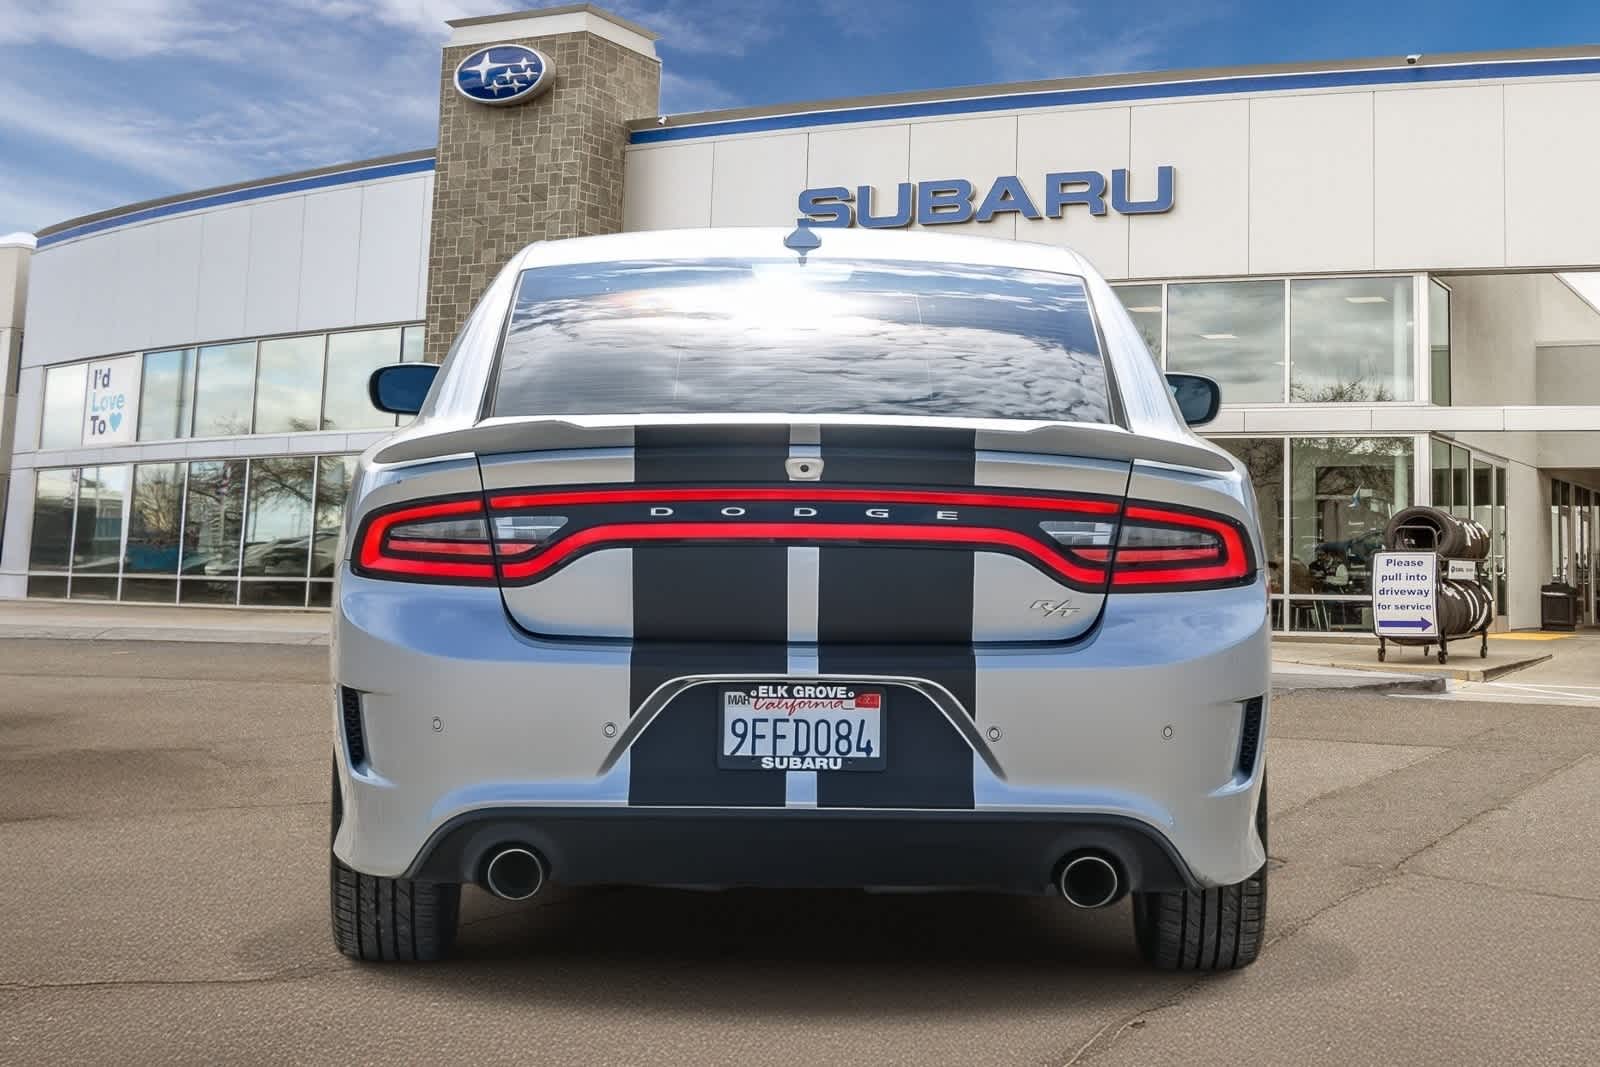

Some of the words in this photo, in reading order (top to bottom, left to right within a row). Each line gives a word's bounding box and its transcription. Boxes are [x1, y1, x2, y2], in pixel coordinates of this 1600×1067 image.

[798, 165, 1176, 228] SUBARU
[94, 368, 111, 389] I'd
[92, 392, 125, 412] Love
[91, 415, 106, 435] To
[650, 506, 959, 520] DODGE
[1386, 558, 1424, 567] Please
[1381, 573, 1402, 583] pull
[1405, 573, 1428, 581] into
[1378, 587, 1430, 598] driveway
[1029, 599, 1081, 617] R/T
[758, 685, 787, 697] ELK
[793, 686, 847, 698] GROVE
[753, 697, 844, 716] California
[730, 718, 874, 757] 9FFD084
[761, 757, 843, 770] SUBARU
